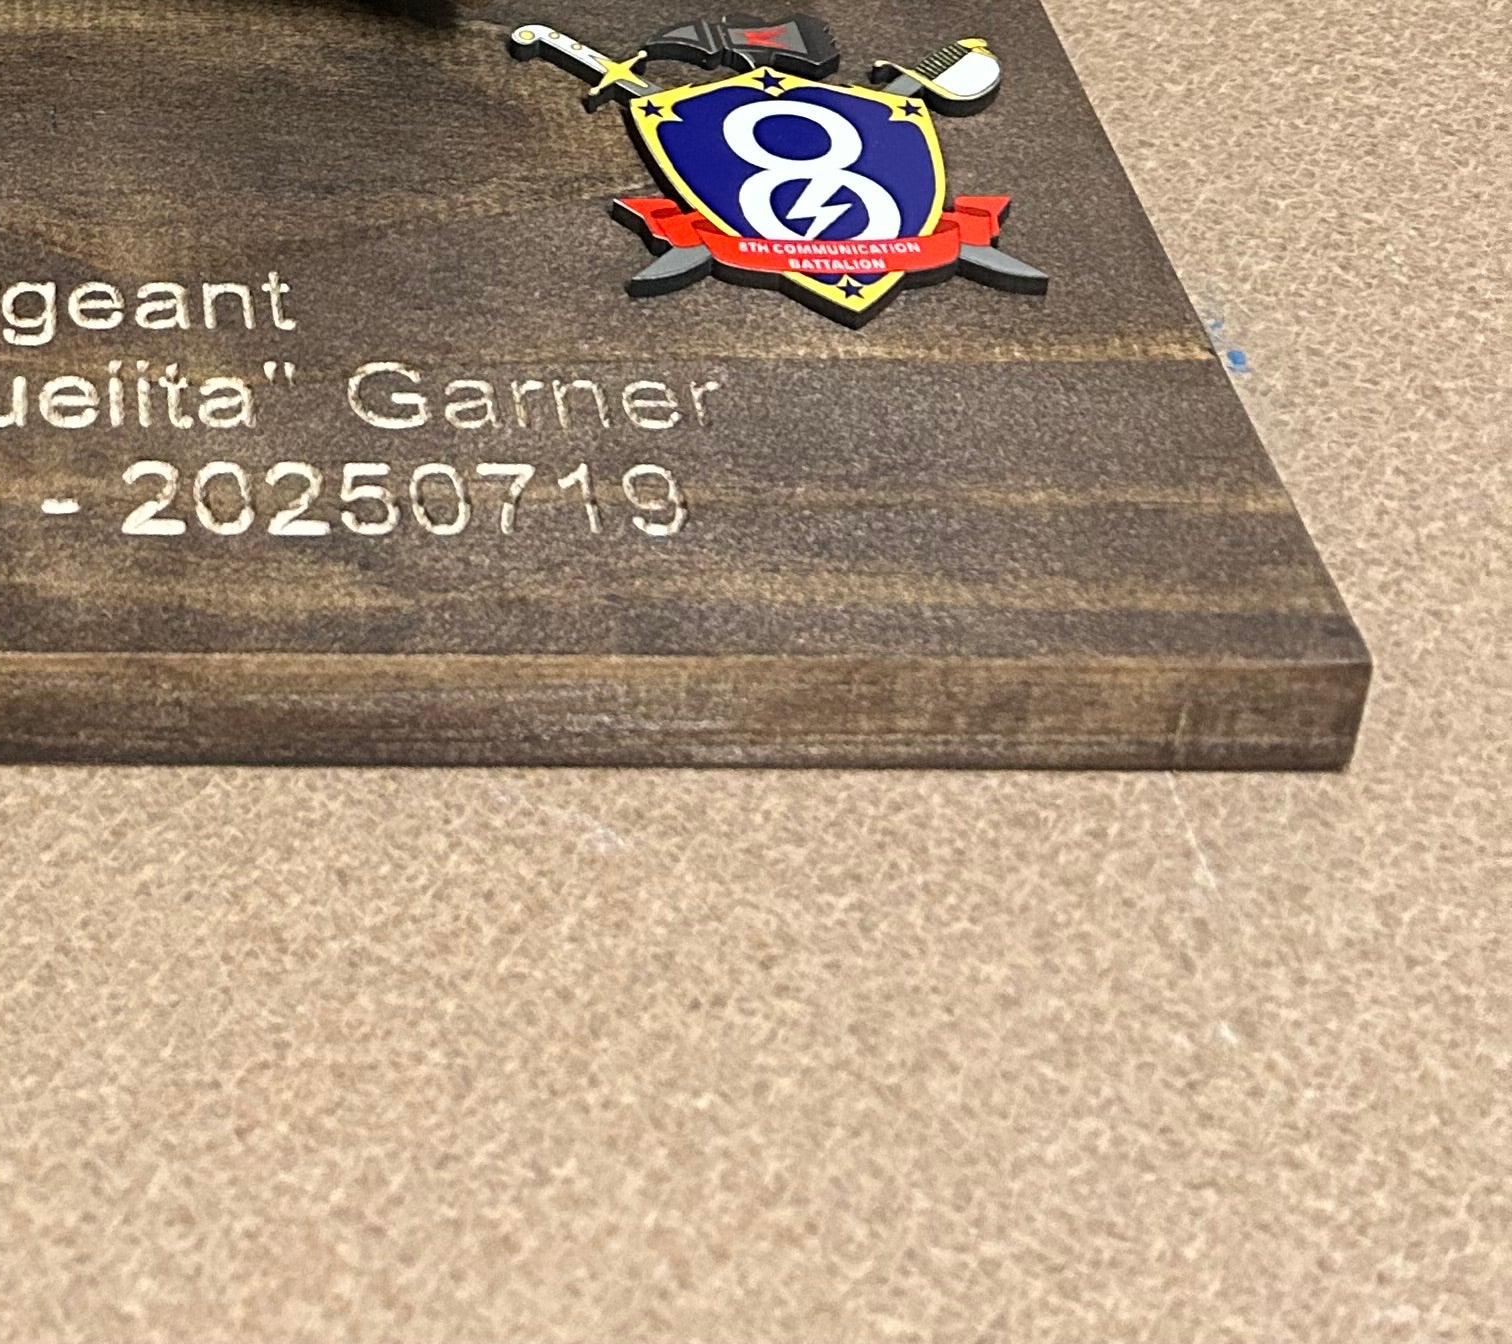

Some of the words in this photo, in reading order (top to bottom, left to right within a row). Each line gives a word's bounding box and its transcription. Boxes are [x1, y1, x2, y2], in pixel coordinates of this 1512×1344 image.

[722, 99, 901, 240] 8
[738, 241, 770, 254] 8TH
[772, 241, 921, 256] COMMUNICATION
[788, 257, 887, 270] BATTALION
[346, 360, 722, 431] Garner
[40, 498, 80, 515] -
[120, 462, 690, 538] 20250719
